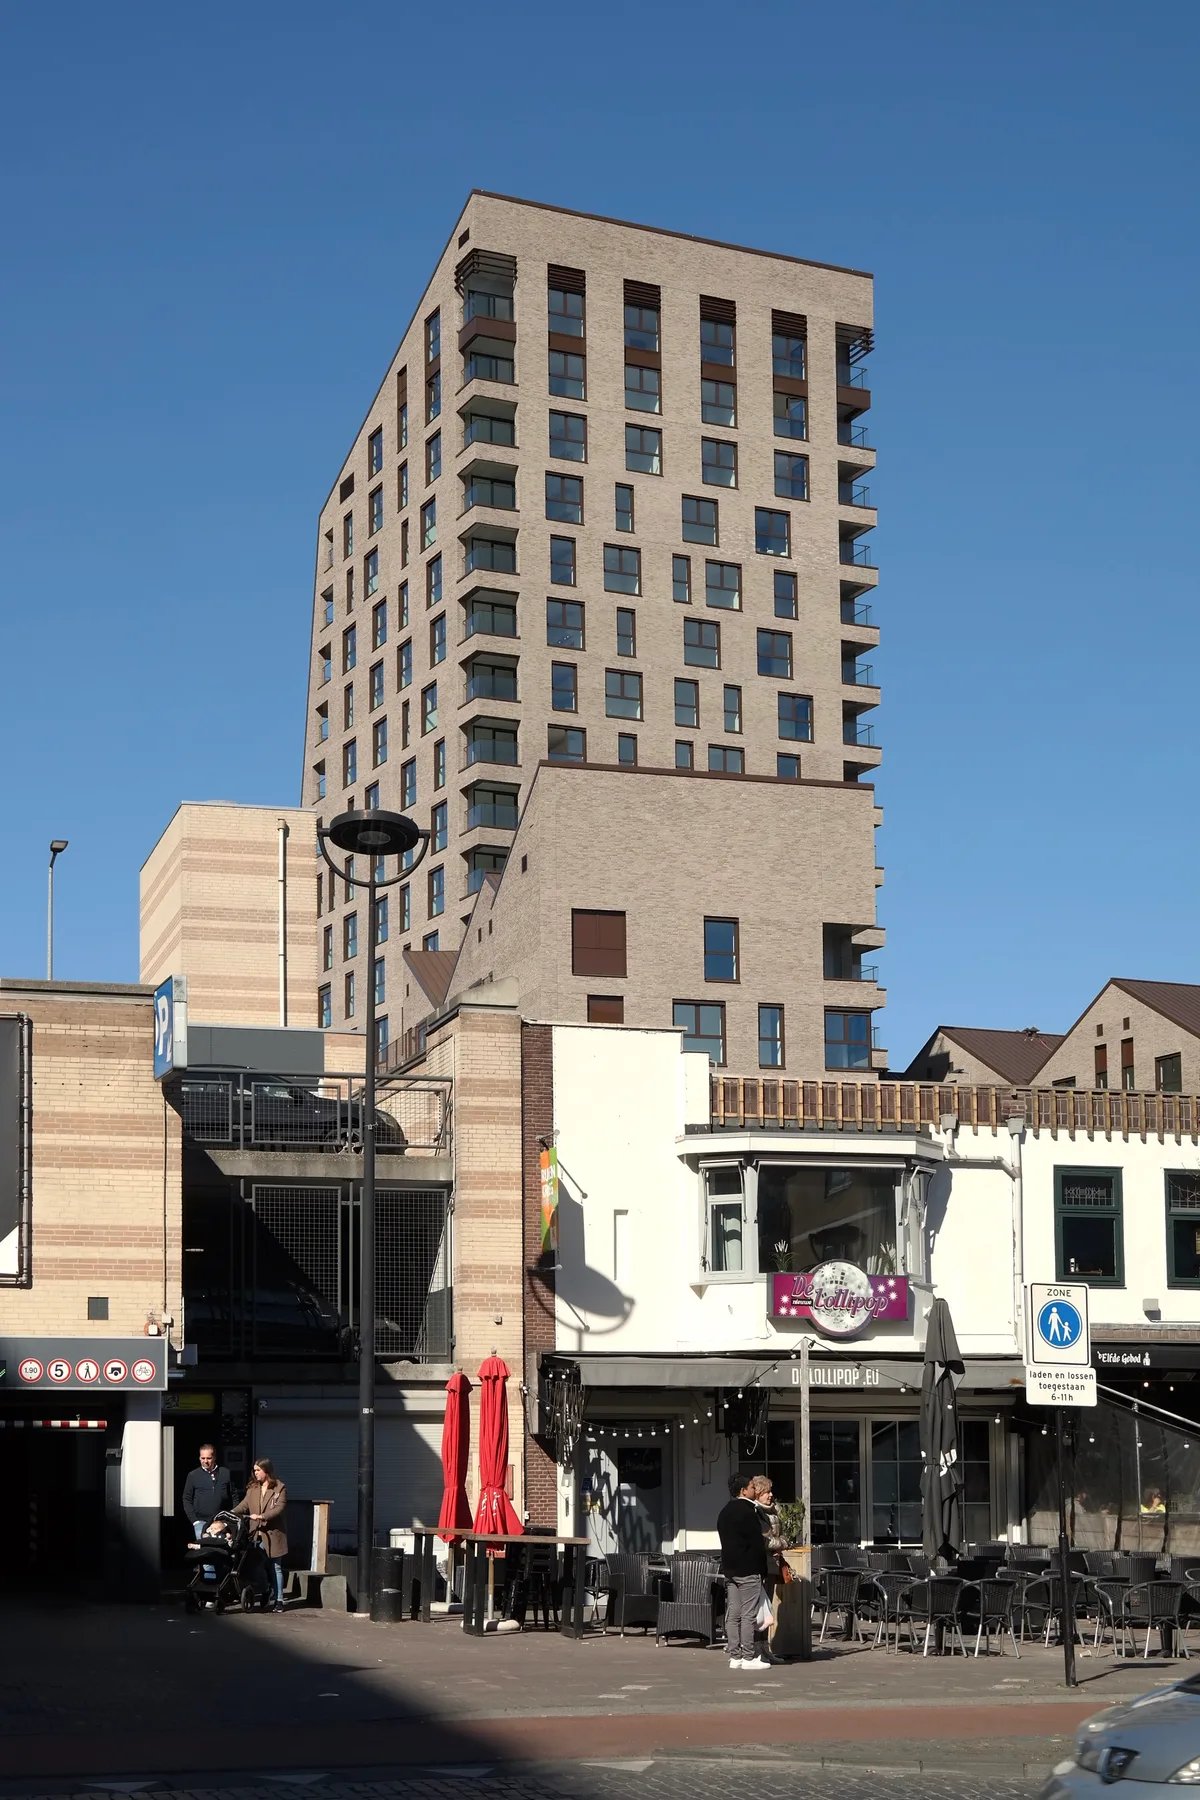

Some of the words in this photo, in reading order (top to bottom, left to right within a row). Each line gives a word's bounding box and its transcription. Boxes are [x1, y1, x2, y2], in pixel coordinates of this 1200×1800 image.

[157, 995, 169, 1056] P
[791, 1275, 814, 1297] De
[1047, 1288, 1072, 1297] ZONE
[814, 1288, 888, 1318] Lollipop
[1121, 1353, 1141, 1364] Gebod
[54, 1364, 64, 1378] 5
[808, 1368, 860, 1385] LOLLIPOP
[1029, 1370, 1053, 1379] laden
[1067, 1371, 1094, 1380] lossen
[1038, 1382, 1085, 1392] toegestaan
